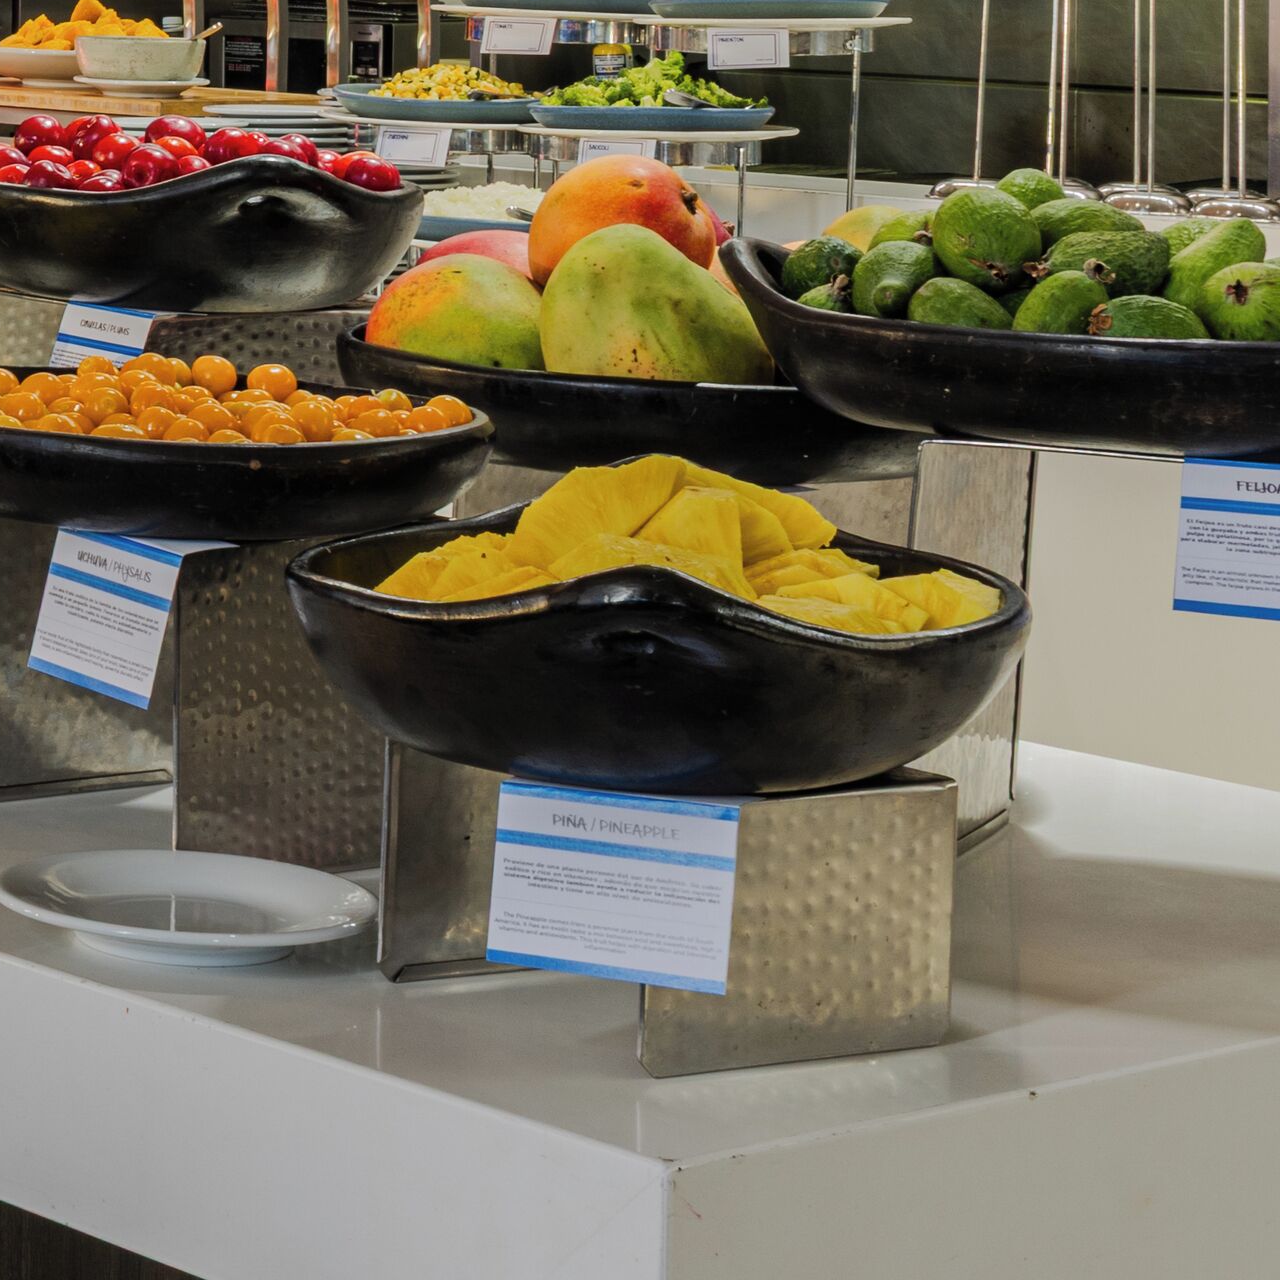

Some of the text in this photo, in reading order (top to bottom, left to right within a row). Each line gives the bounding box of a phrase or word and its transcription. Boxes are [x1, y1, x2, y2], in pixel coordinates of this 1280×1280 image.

[77, 549, 107, 572] UCHUVA
[113, 560, 153, 583] PHYSALIS
[552, 812, 588, 832] PIÑA
[599, 819, 681, 842] PINEAPPLE
